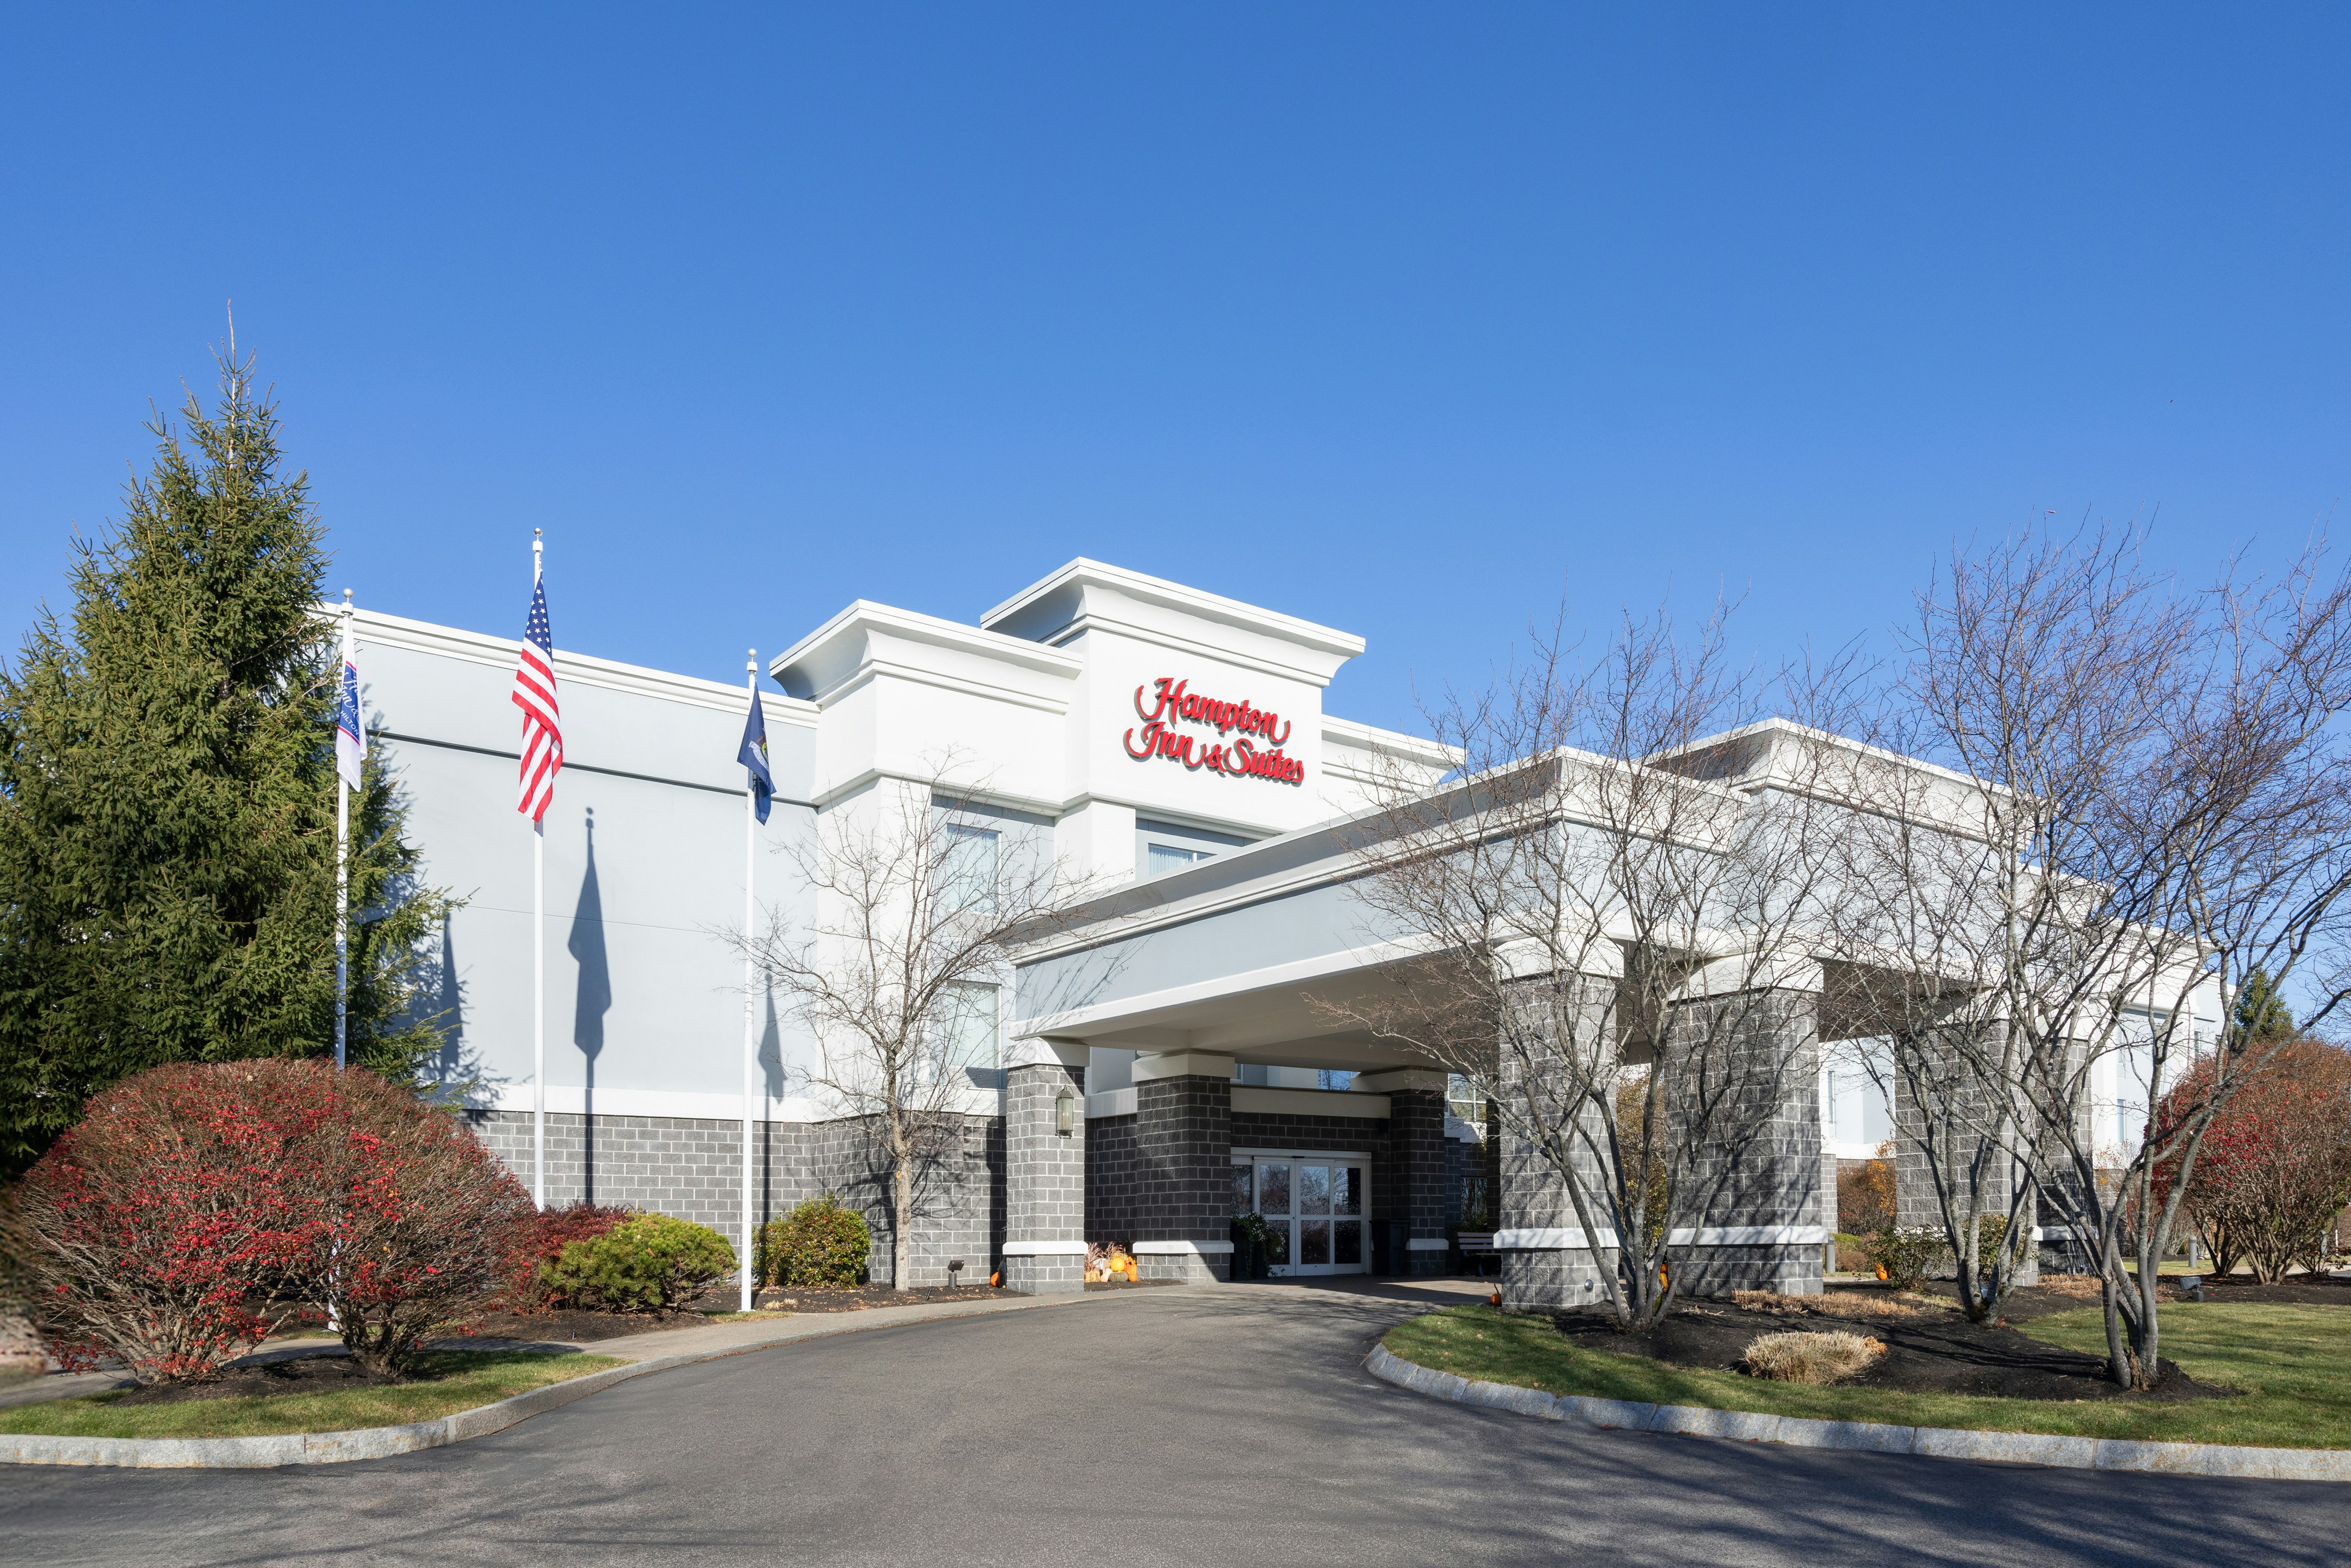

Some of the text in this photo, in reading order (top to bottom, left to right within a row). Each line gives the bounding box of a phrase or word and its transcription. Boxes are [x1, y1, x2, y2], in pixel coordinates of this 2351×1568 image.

[340, 710, 359, 735] HILTON
[1135, 677, 1290, 742] Hampton
[1124, 721, 1304, 782] Inn & Suites
